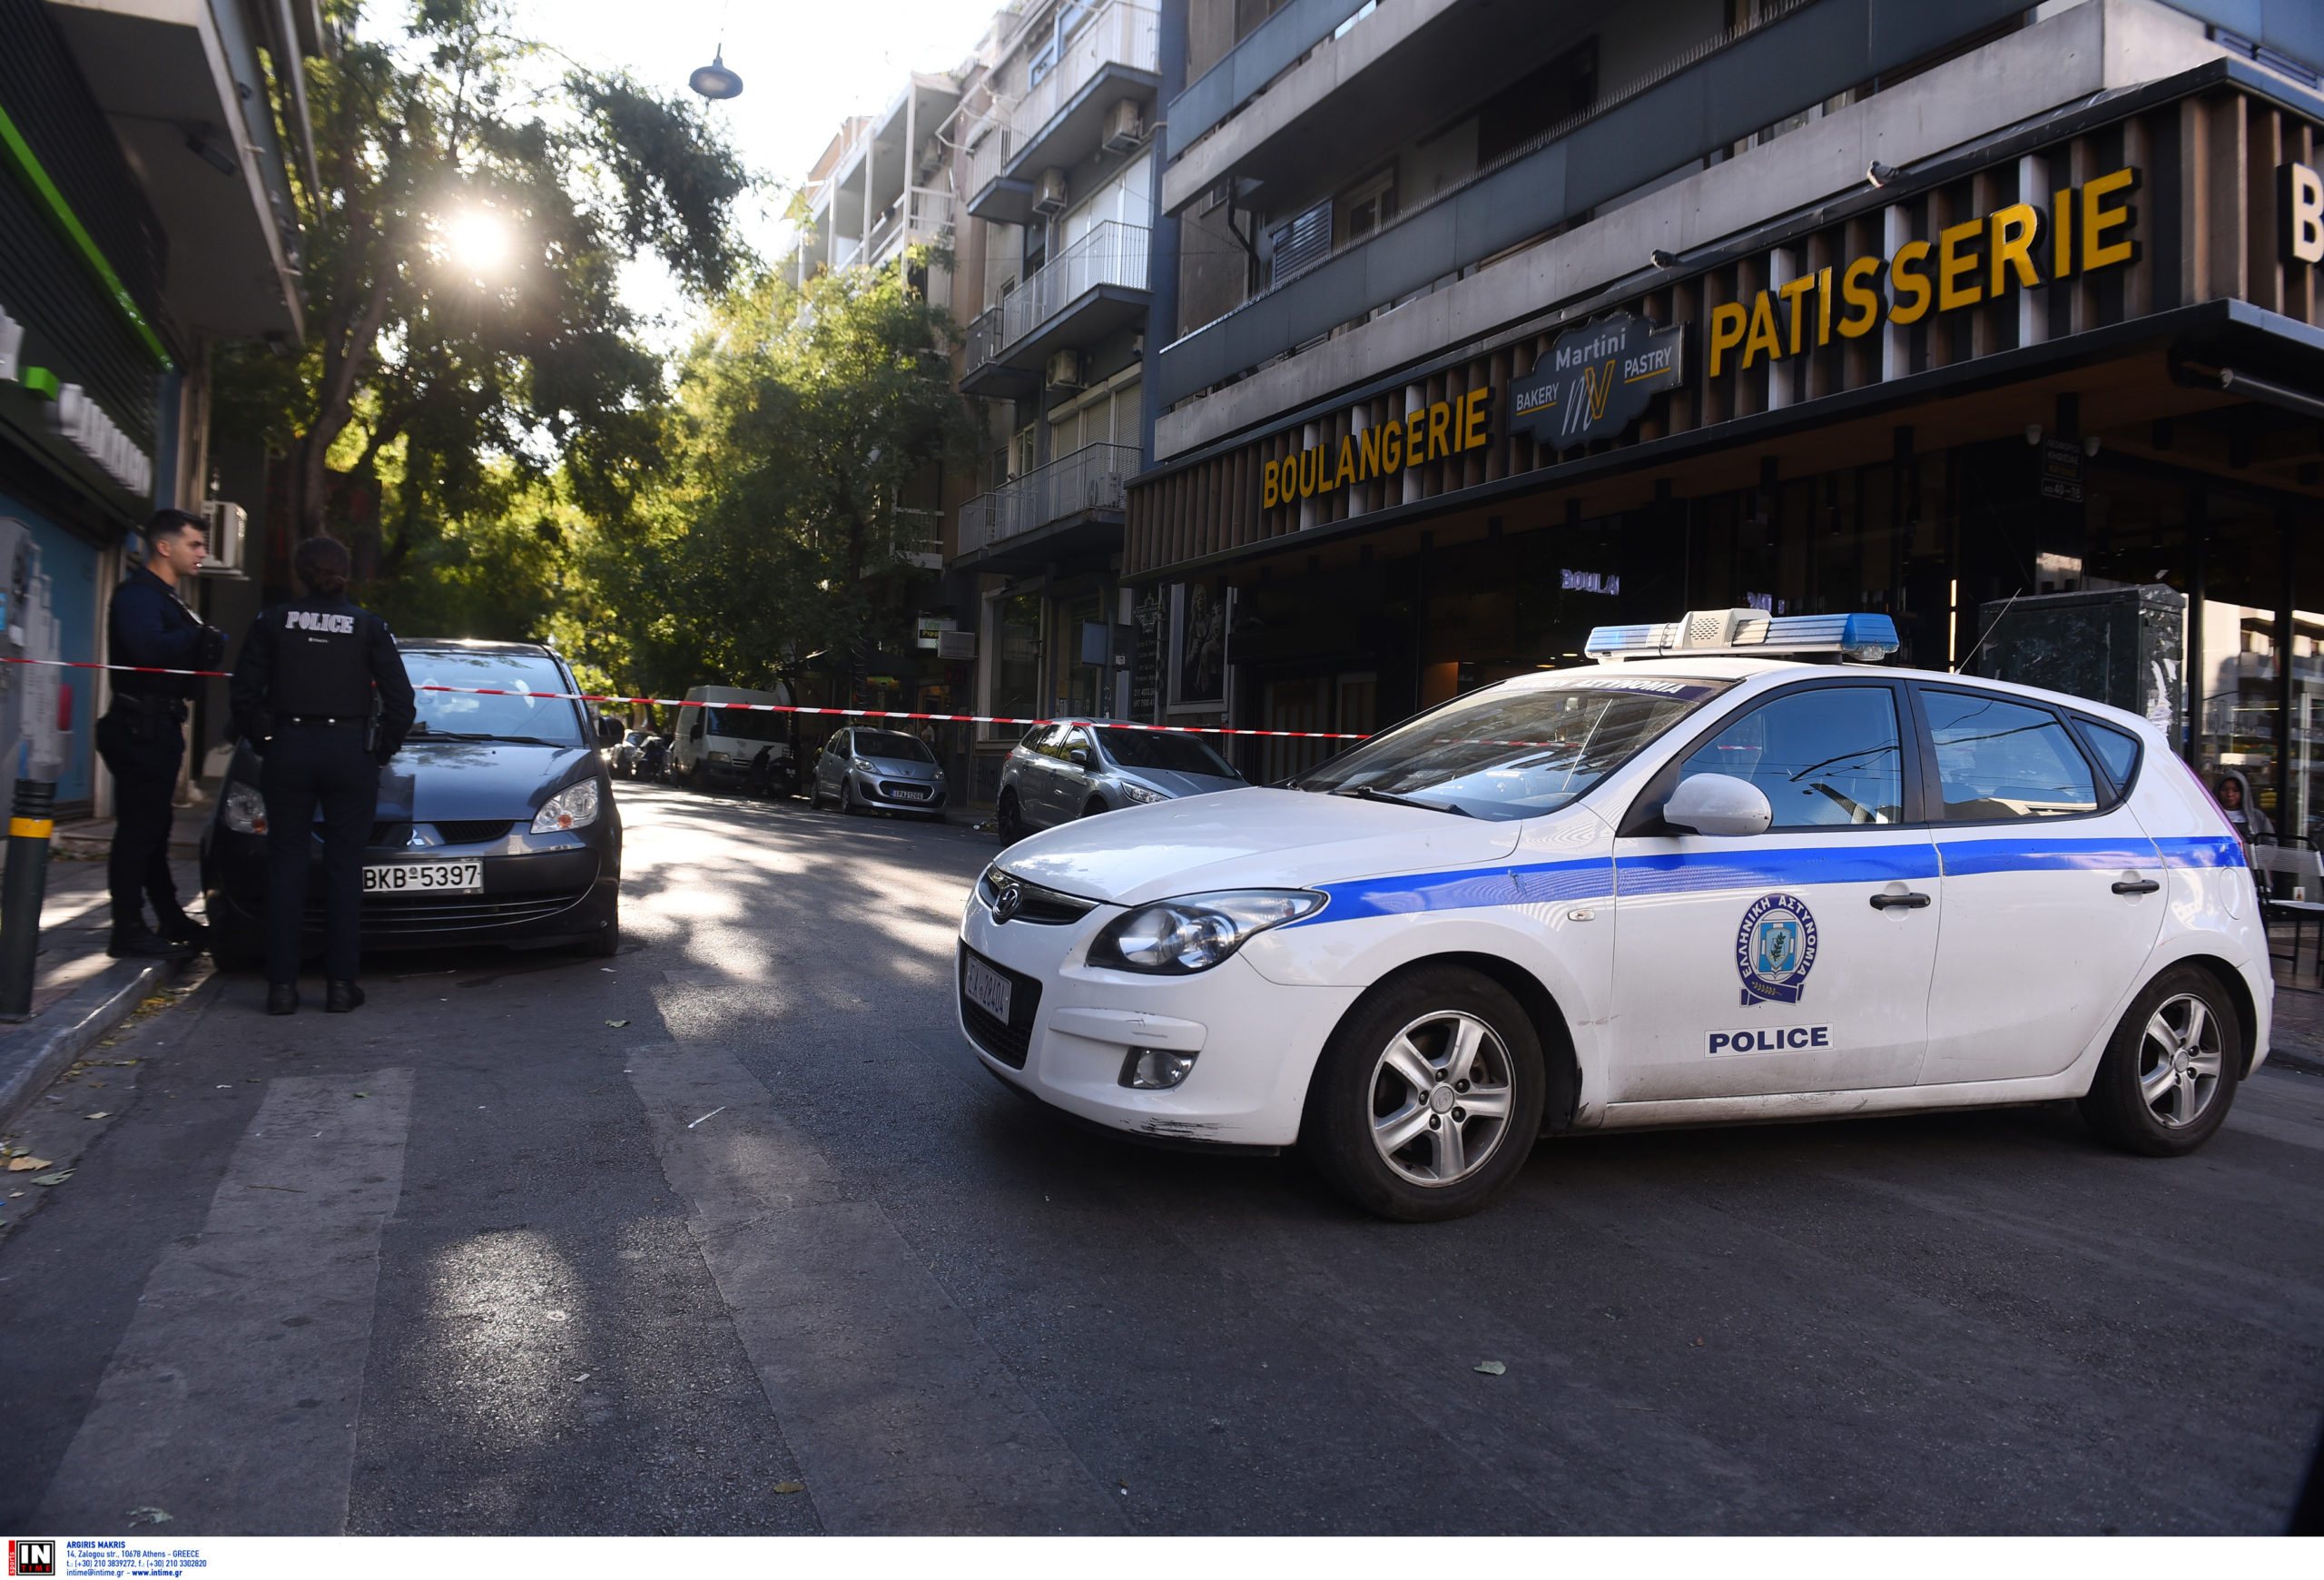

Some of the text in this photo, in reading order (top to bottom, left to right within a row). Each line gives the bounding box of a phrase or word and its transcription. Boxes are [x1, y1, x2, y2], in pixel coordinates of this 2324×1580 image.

[1710, 167, 2133, 378] PATISSERIE
[1555, 327, 1626, 371] Martini
[1624, 346, 1672, 379] PASTRY
[1516, 381, 1560, 411] BAKERY
[1264, 386, 1489, 509] BOULANGERIE
[285, 610, 355, 634] POLICE
[1738, 894, 1817, 979] ΕΛΛΗΝΙΚΗ ΑΣΤΥΝΟΜΙΑ
[1709, 1026, 1829, 1054] POLICE
